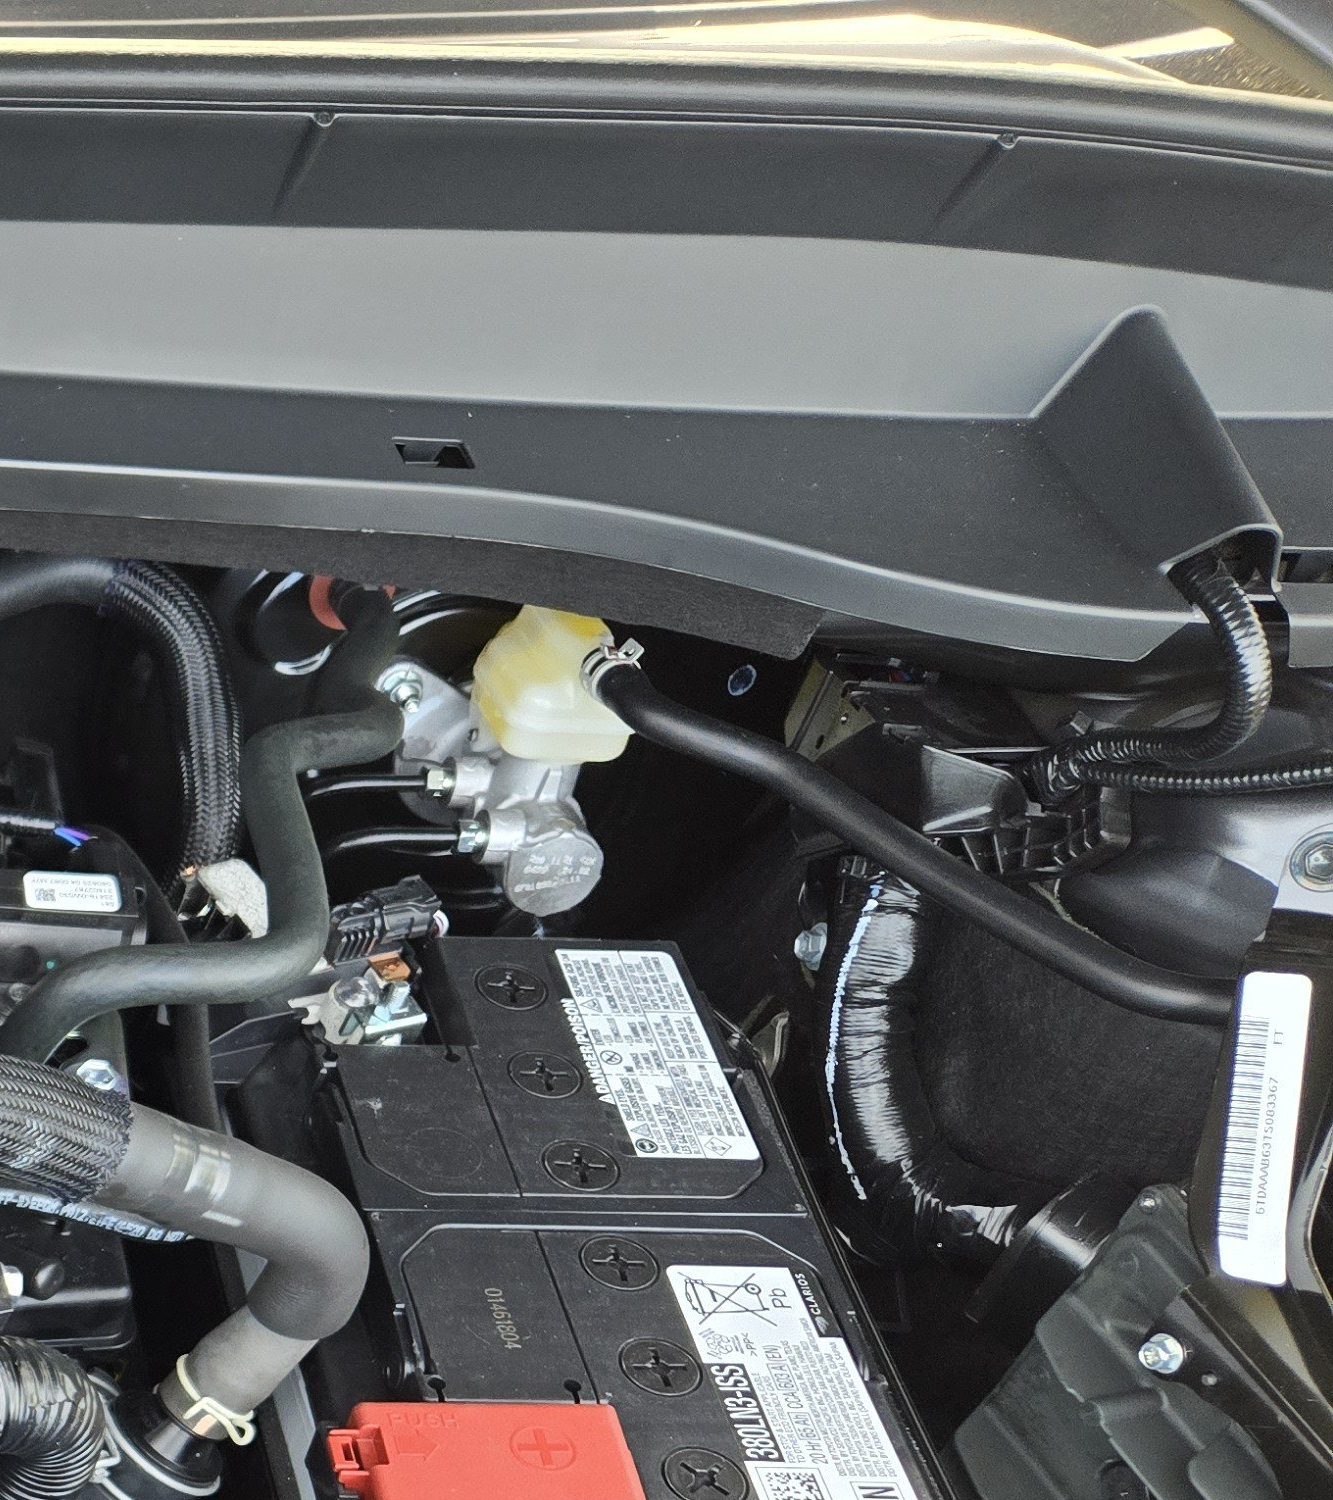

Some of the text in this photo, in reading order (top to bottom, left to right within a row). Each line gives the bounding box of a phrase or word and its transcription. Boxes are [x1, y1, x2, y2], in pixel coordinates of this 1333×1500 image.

[558, 997, 612, 1094] DANGER/POISON
[766, 1287, 792, 1309] Pb
[793, 1272, 822, 1314] CLARIOS
[484, 1287, 522, 1350] 01461804
[708, 1364, 781, 1459] 380LN3-ISS
[782, 1392, 803, 1408] CCA
[808, 1453, 828, 1463] 20
